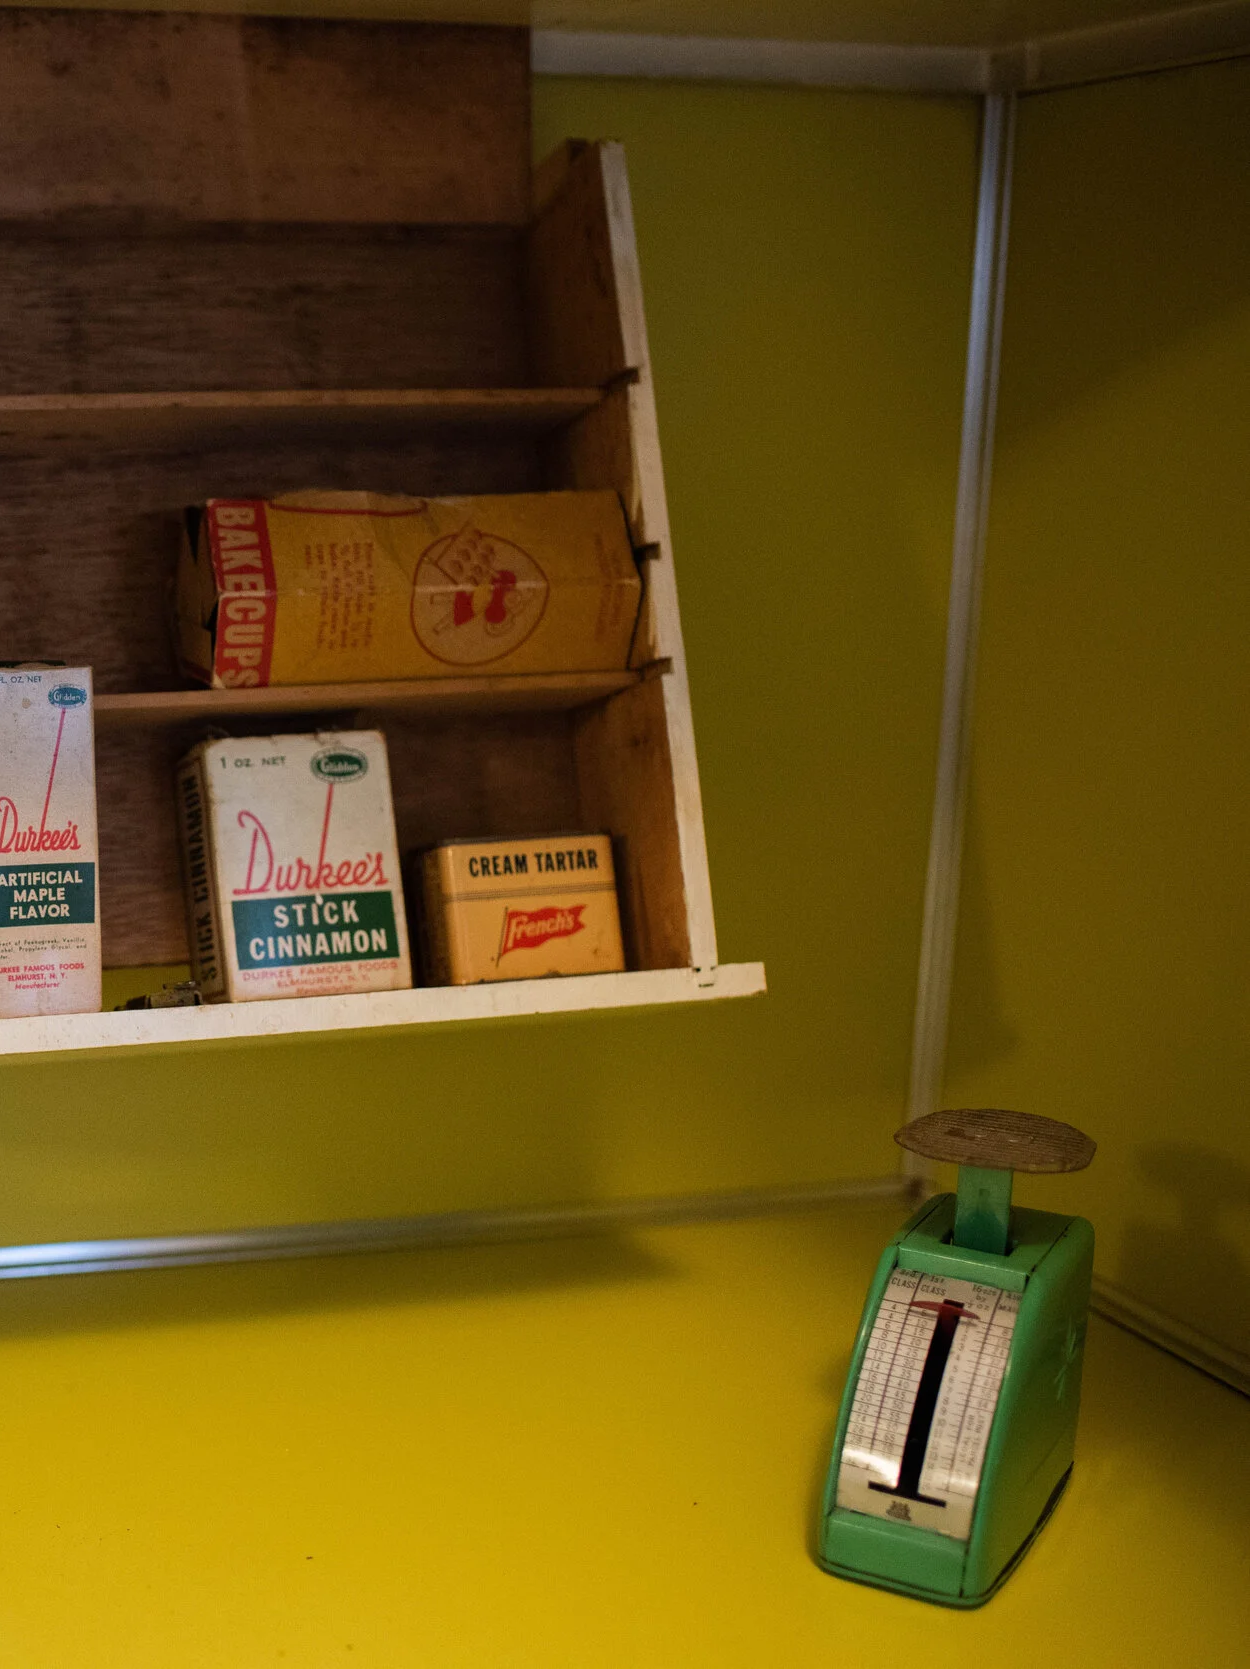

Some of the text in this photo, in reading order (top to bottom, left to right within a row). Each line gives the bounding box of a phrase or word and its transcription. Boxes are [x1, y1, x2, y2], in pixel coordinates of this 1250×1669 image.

[27, 675, 42, 683] NET
[220, 756, 227, 769] 1
[261, 755, 287, 766] NET
[469, 849, 599, 877] CREAM TARTAR
[181, 775, 217, 982] STICK CINNAMON
[13, 887, 66, 904] MAPLE
[9, 903, 70, 920] FLAVOR
[274, 899, 360, 929] STICK
[508, 910, 575, 950] French's
[249, 928, 388, 962] CINNAMON
[23, 964, 55, 972] FAMOUS
[59, 962, 85, 970] FOODS
[242, 959, 399, 983] DURKEE FAMOUS FOODS
[8, 973, 47, 982] ELMHURST,
[15, 982, 60, 990] Manufacturer
[891, 1277, 917, 1289] CLASS
[920, 1284, 947, 1296] CLASS
